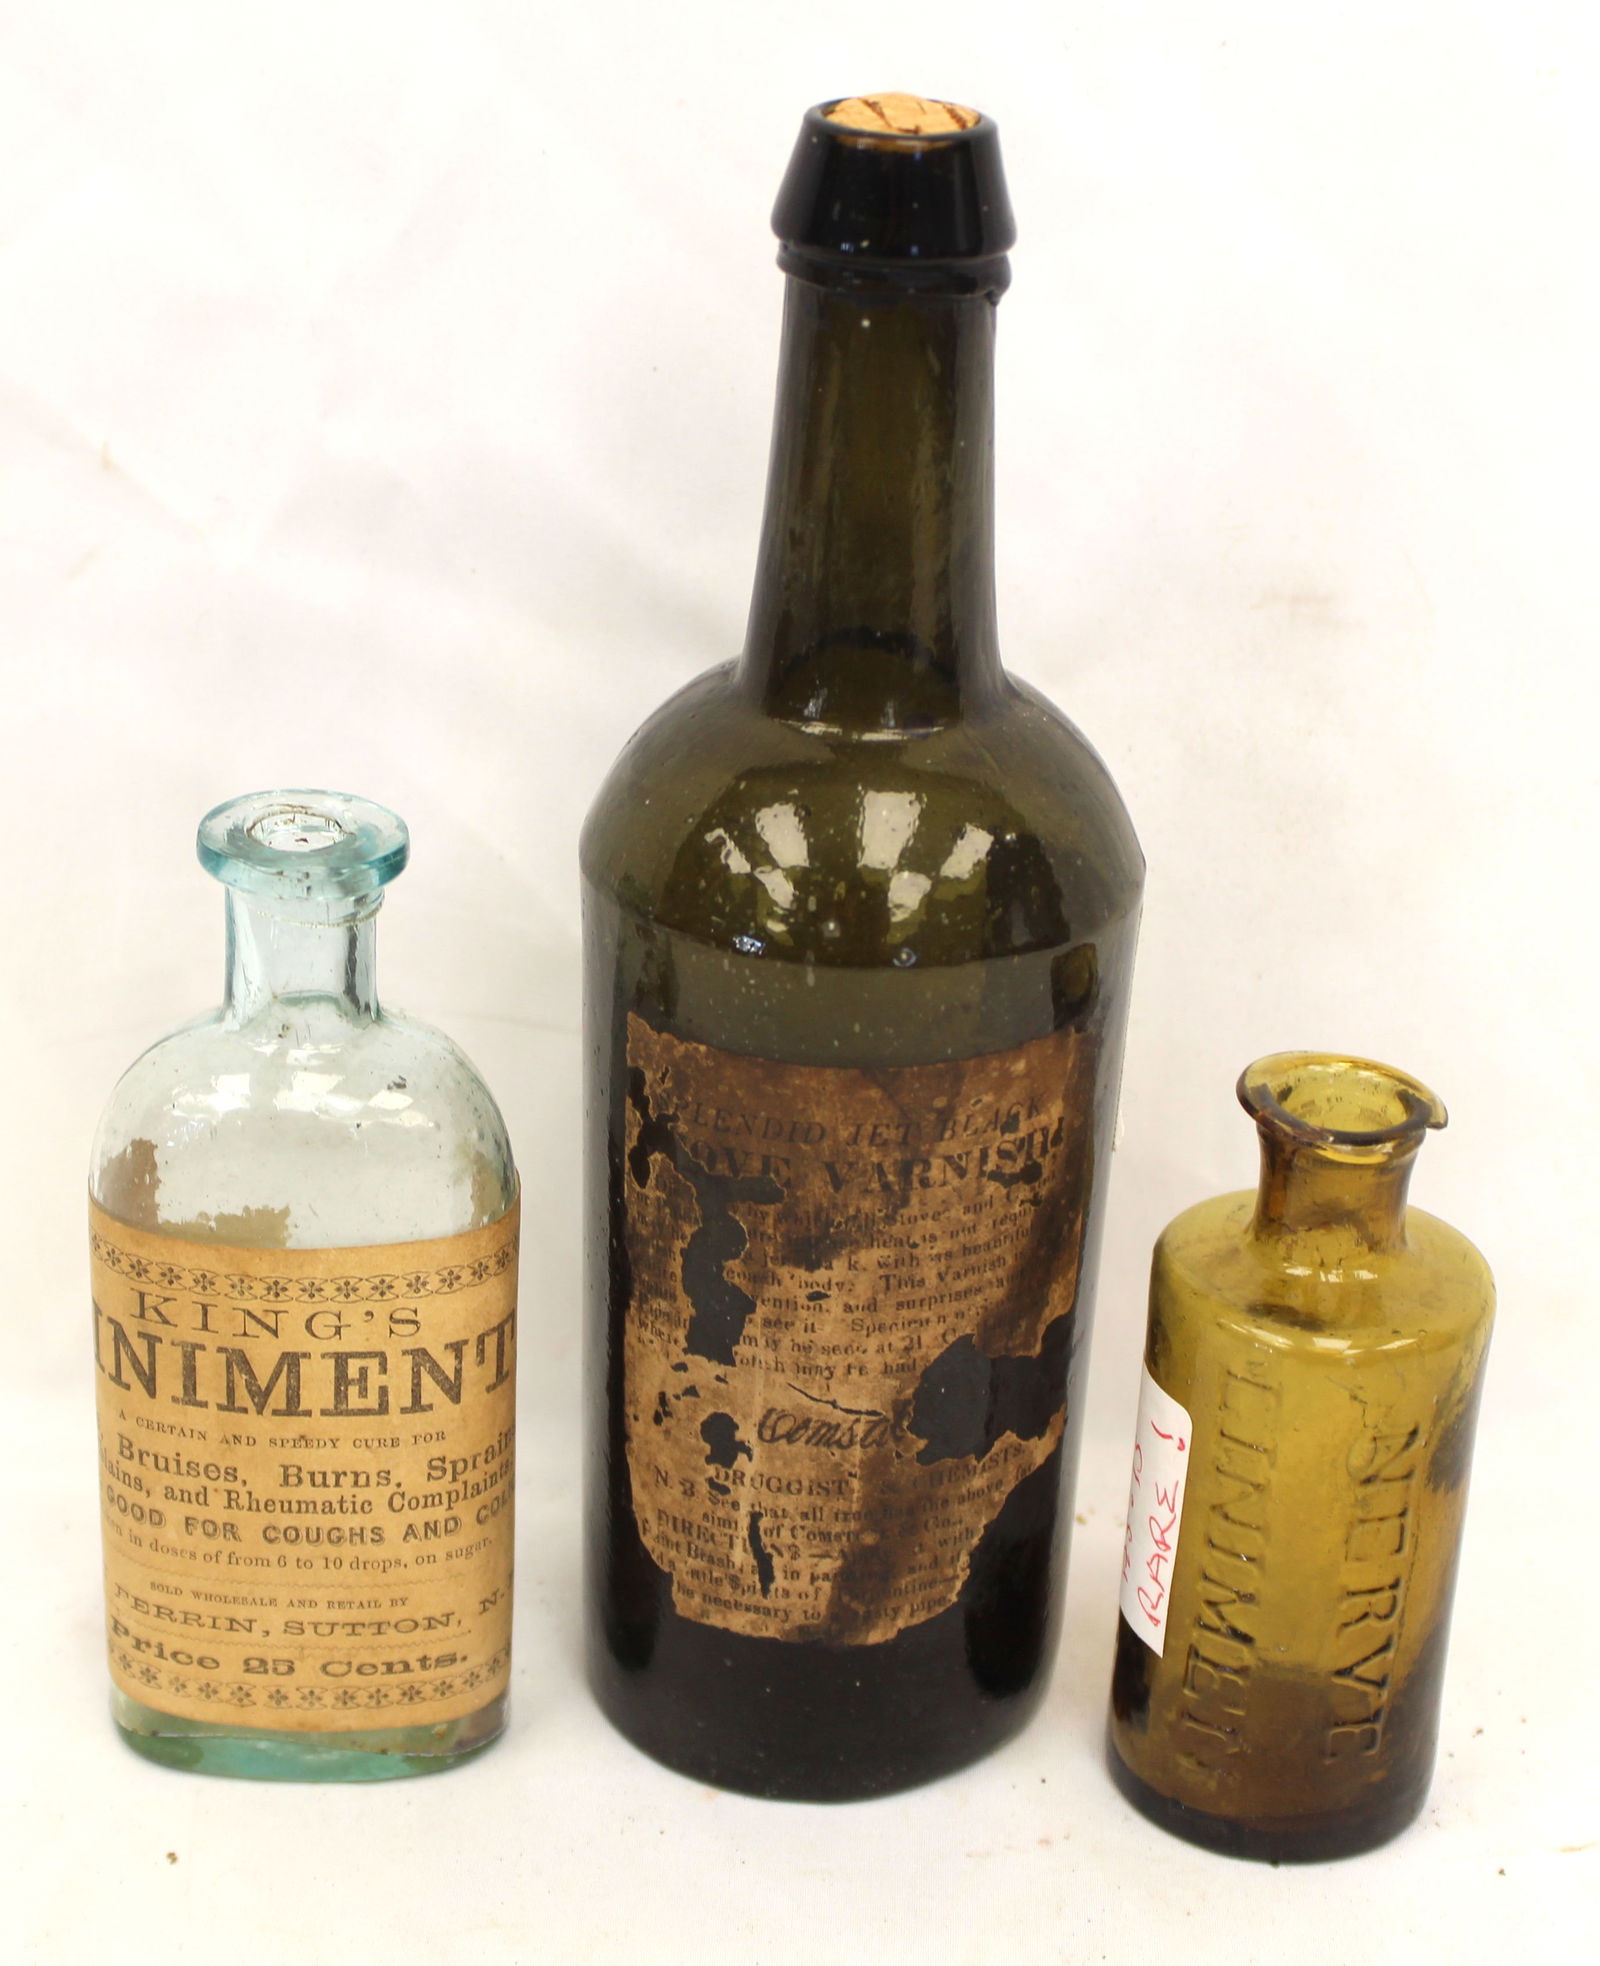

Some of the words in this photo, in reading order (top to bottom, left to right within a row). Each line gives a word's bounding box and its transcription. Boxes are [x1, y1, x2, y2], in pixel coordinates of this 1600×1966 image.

[129, 1287, 422, 1341] KING'S
[118, 1409, 128, 1421] A
[135, 1415, 209, 1441] CERTAIN
[219, 1433, 258, 1446] AND
[268, 1433, 340, 1449] SPEEDY
[352, 1437, 401, 1450] CURE
[411, 1430, 447, 1446] FOR
[116, 1432, 248, 1488] Bruises,
[106, 1484, 167, 1529] GOOD
[184, 1515, 243, 1543] FOR
[261, 1524, 385, 1546] COUGHS
[402, 1515, 463, 1543] AND
[163, 1485, 210, 1507] and
[222, 1488, 374, 1516] Rheumatic
[128, 1527, 143, 1548] in
[149, 1538, 198, 1562] doses
[202, 1550, 222, 1566] of
[226, 1550, 271, 1569] from
[276, 1554, 288, 1569] 6
[295, 1555, 314, 1570] to
[321, 1556, 343, 1570] 10
[415, 1554, 437, 1566] on
[286, 1598, 318, 1610] AND
[326, 1598, 383, 1610] RETAIL
[389, 1596, 410, 1608] BY
[1326, 1423, 1420, 1760] NERVE
[110, 1614, 220, 1671] Price
[242, 1656, 296, 1676] 25
[319, 1651, 469, 1678] Cents.
[282, 1611, 462, 1637] SUTTON,
